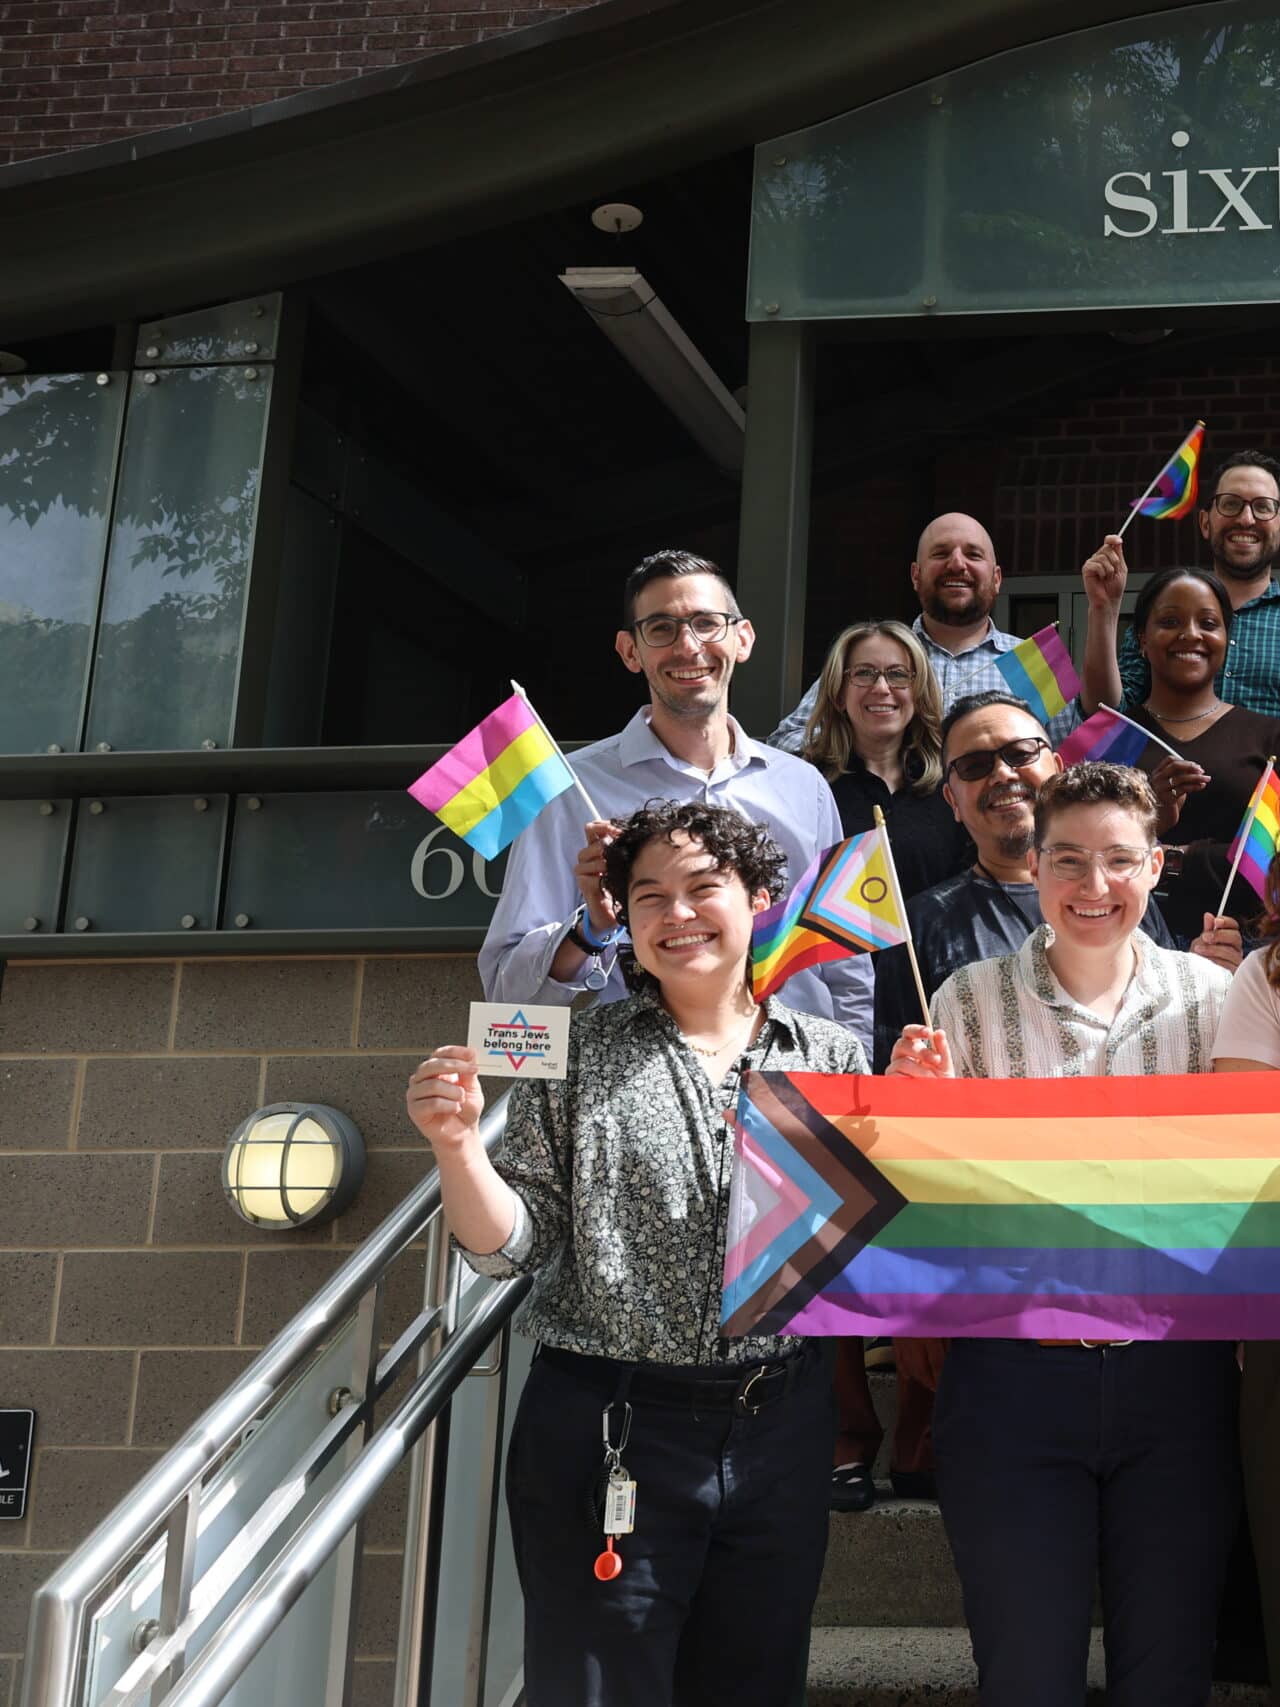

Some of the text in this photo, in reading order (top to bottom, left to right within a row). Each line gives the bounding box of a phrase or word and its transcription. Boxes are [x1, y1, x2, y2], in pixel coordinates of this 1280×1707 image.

[488, 1028, 550, 1040] Trans Jews
[484, 1038, 551, 1051] belong here
[0, 1495, 15, 1505] LE
